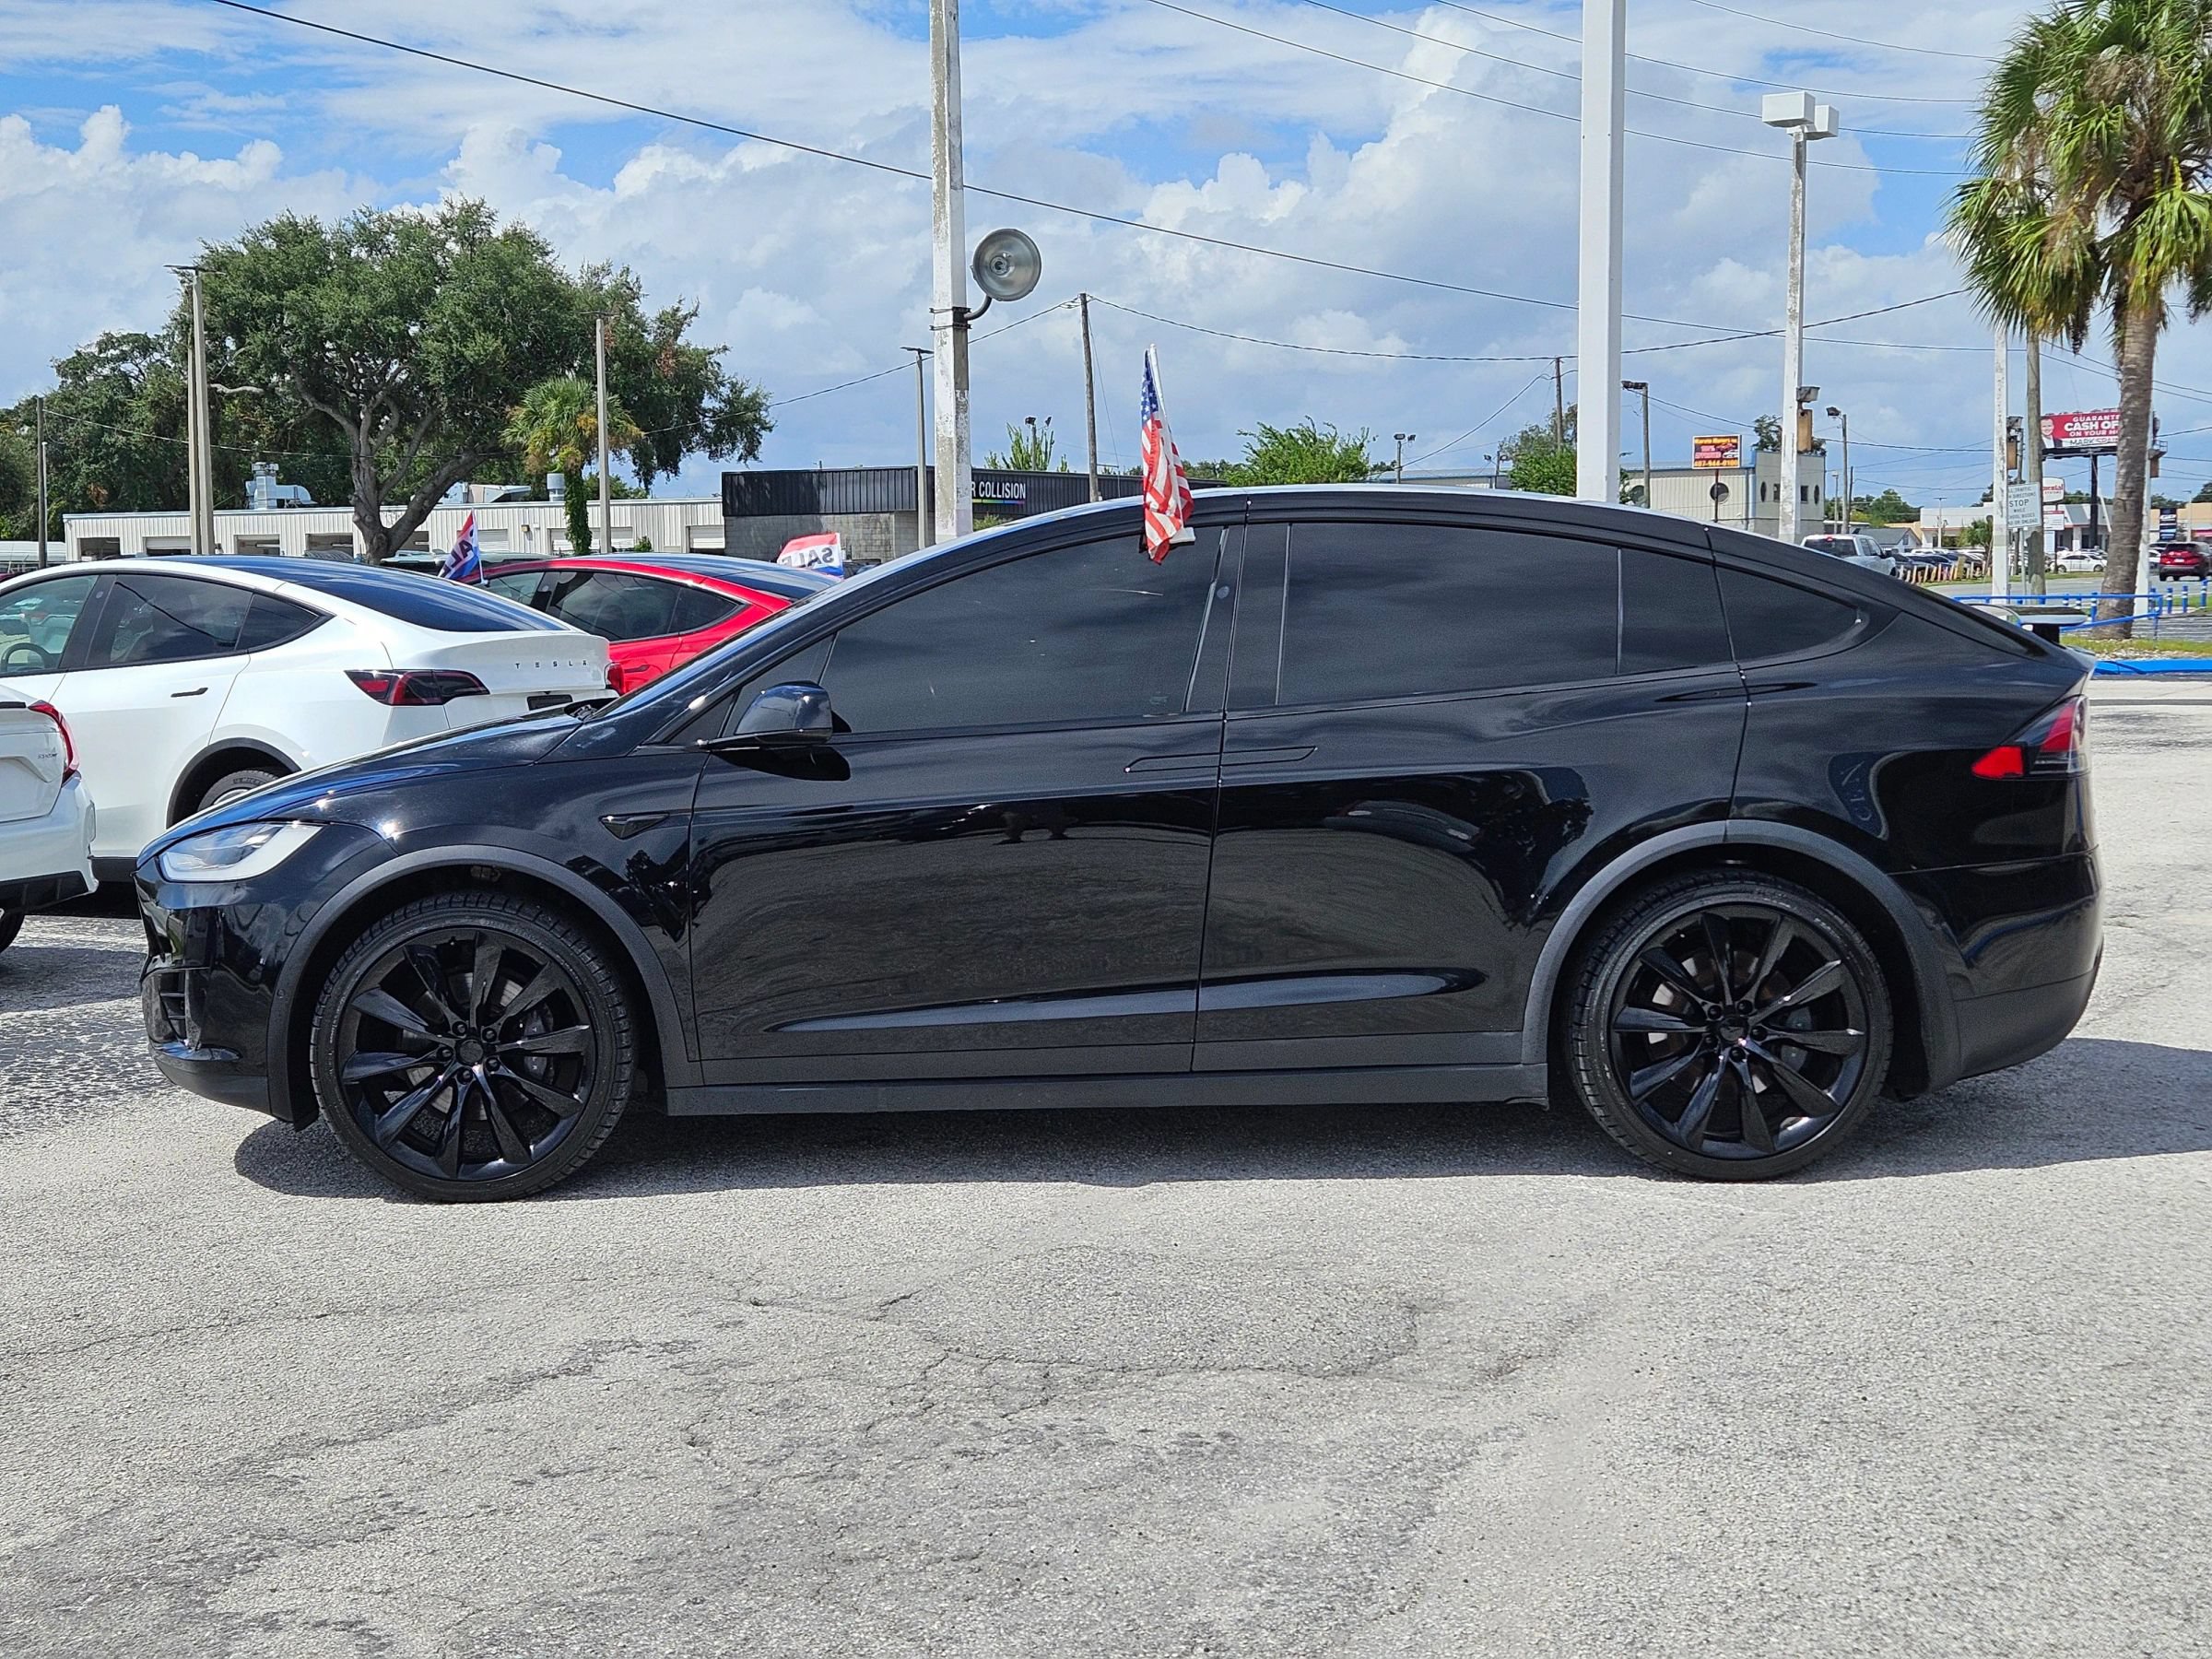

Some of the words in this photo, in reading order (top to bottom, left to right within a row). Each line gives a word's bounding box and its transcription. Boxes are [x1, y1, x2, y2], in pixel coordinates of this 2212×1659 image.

[2065, 421, 2099, 431] CASH
[979, 481, 1026, 499] COLLISION
[2009, 499, 2030, 508] STOP
[514, 660, 587, 669] TESLA
